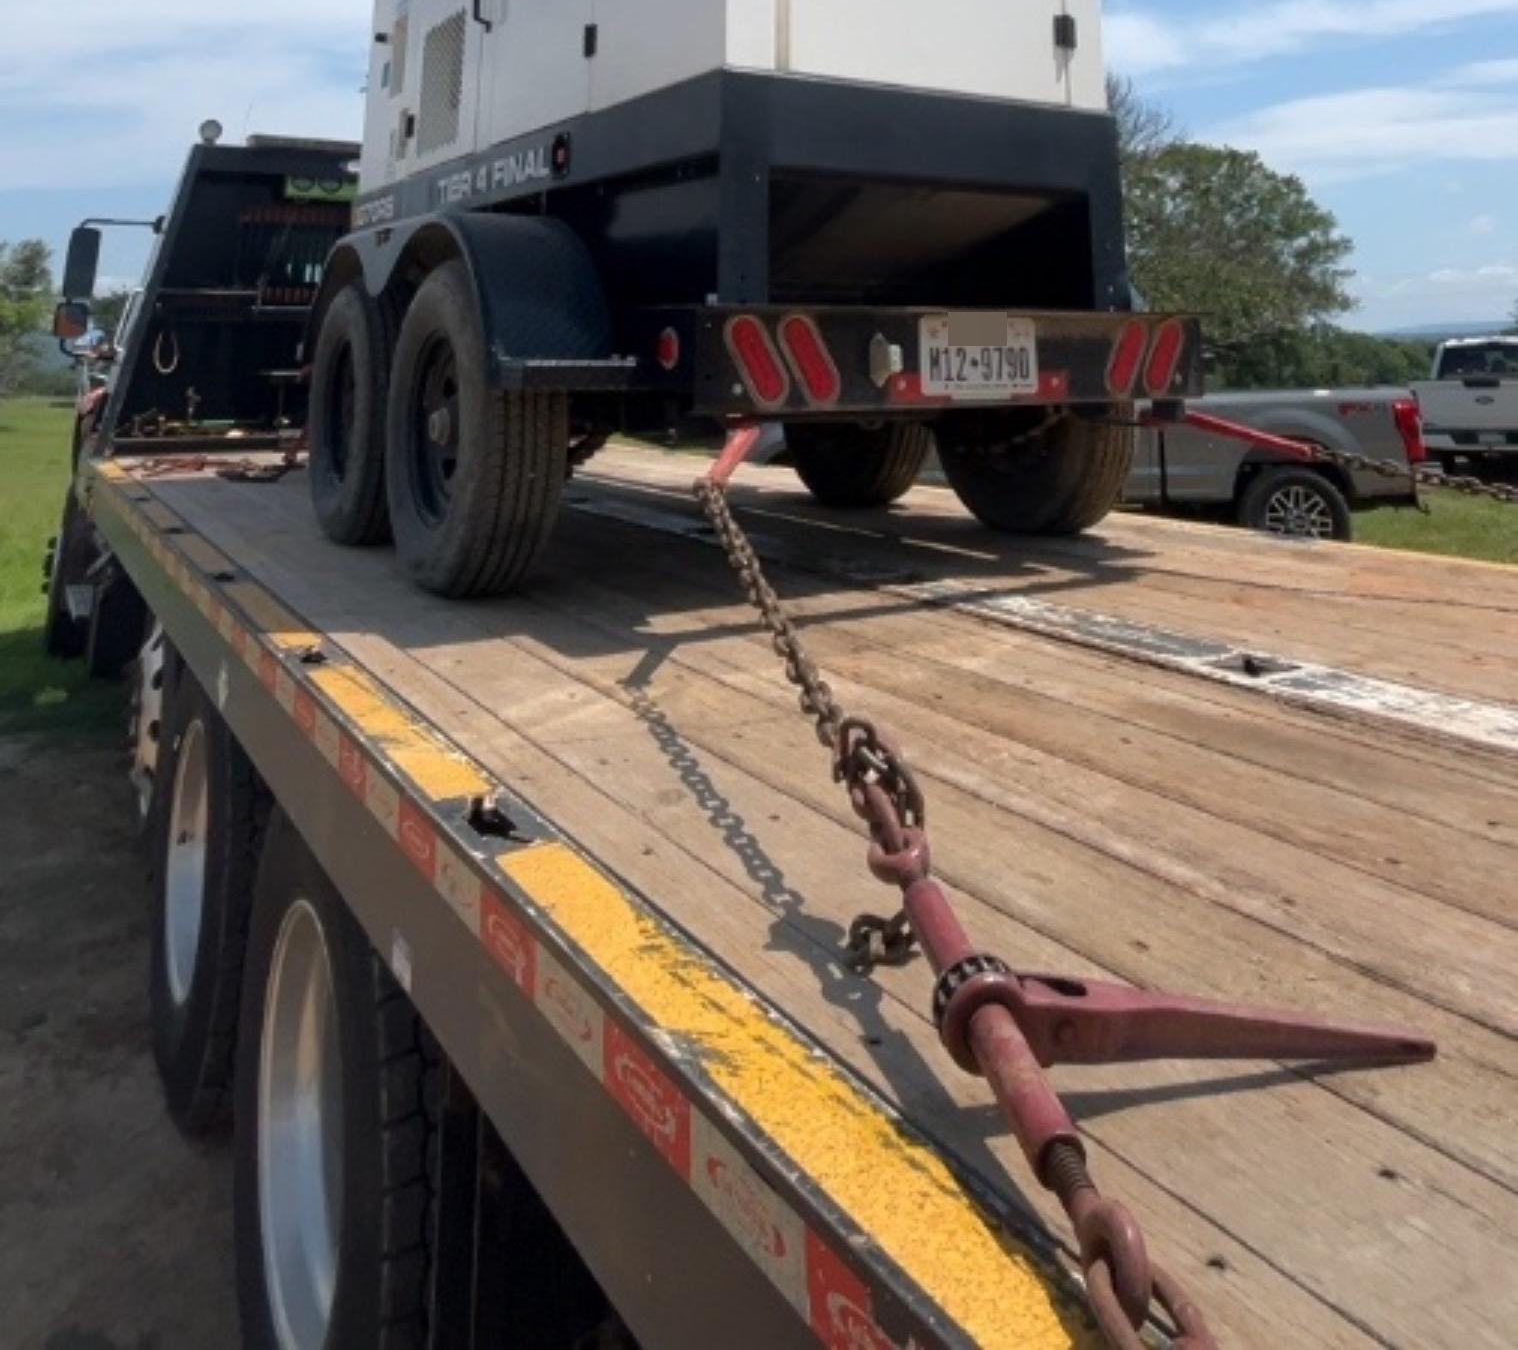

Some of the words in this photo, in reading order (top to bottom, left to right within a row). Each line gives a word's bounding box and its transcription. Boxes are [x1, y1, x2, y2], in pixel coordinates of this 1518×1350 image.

[437, 169, 472, 206] TIER
[476, 164, 487, 193] 4
[491, 146, 550, 188] FINAL
